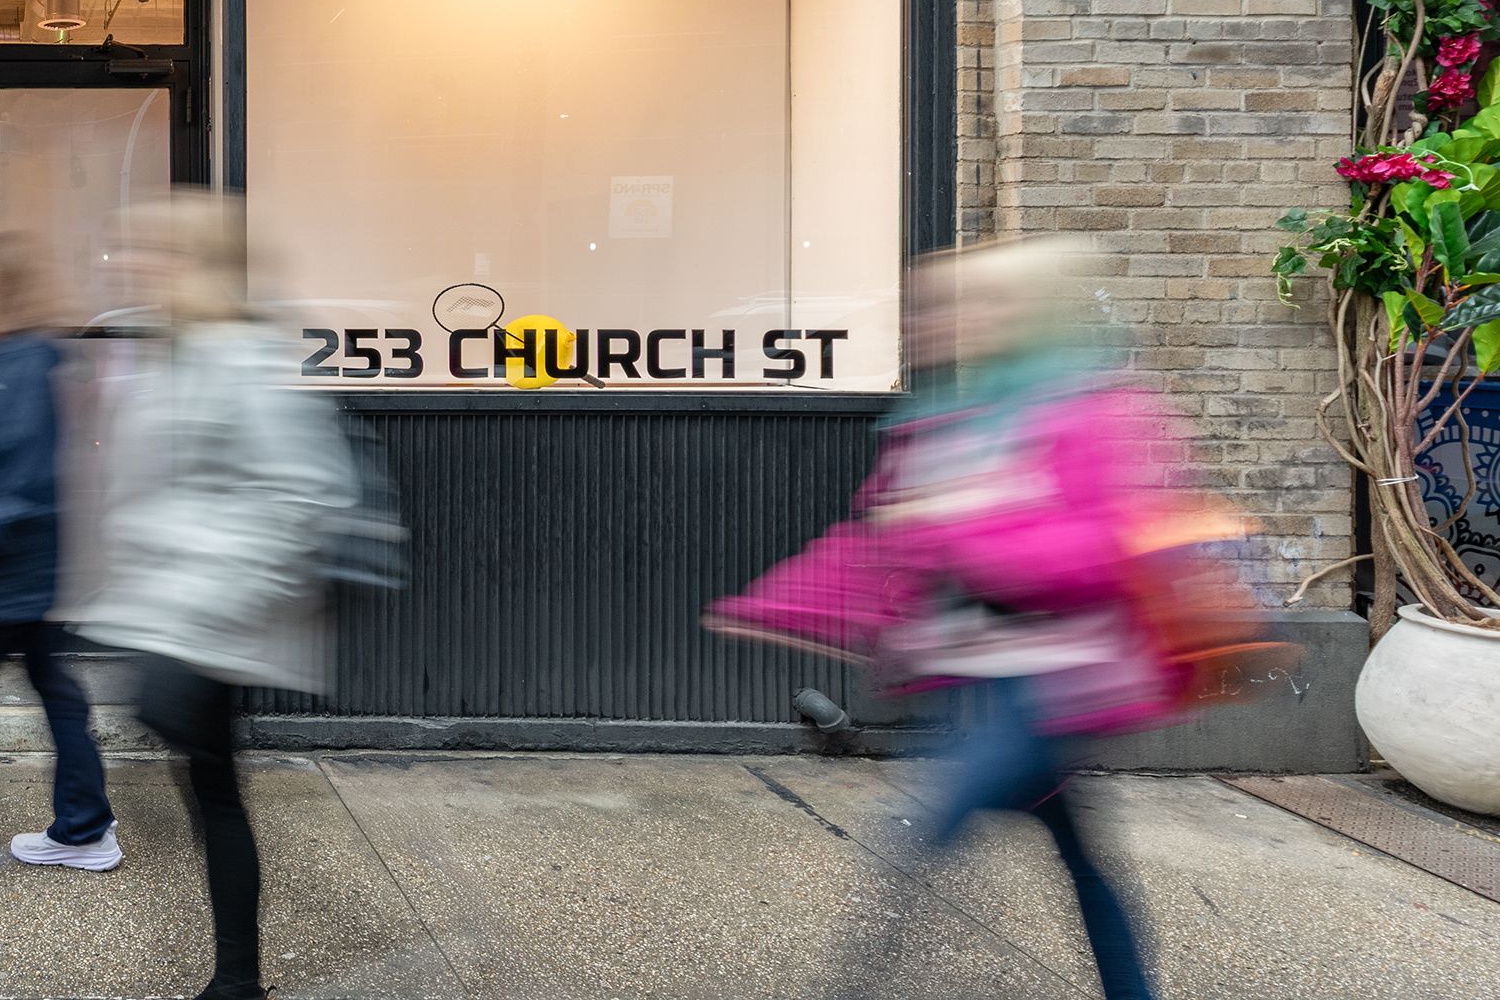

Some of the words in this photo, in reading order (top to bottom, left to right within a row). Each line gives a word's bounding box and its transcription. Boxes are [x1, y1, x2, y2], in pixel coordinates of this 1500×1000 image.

[301, 328, 424, 379] 253
[449, 328, 735, 379] CHURCH
[763, 329, 848, 379] ST
